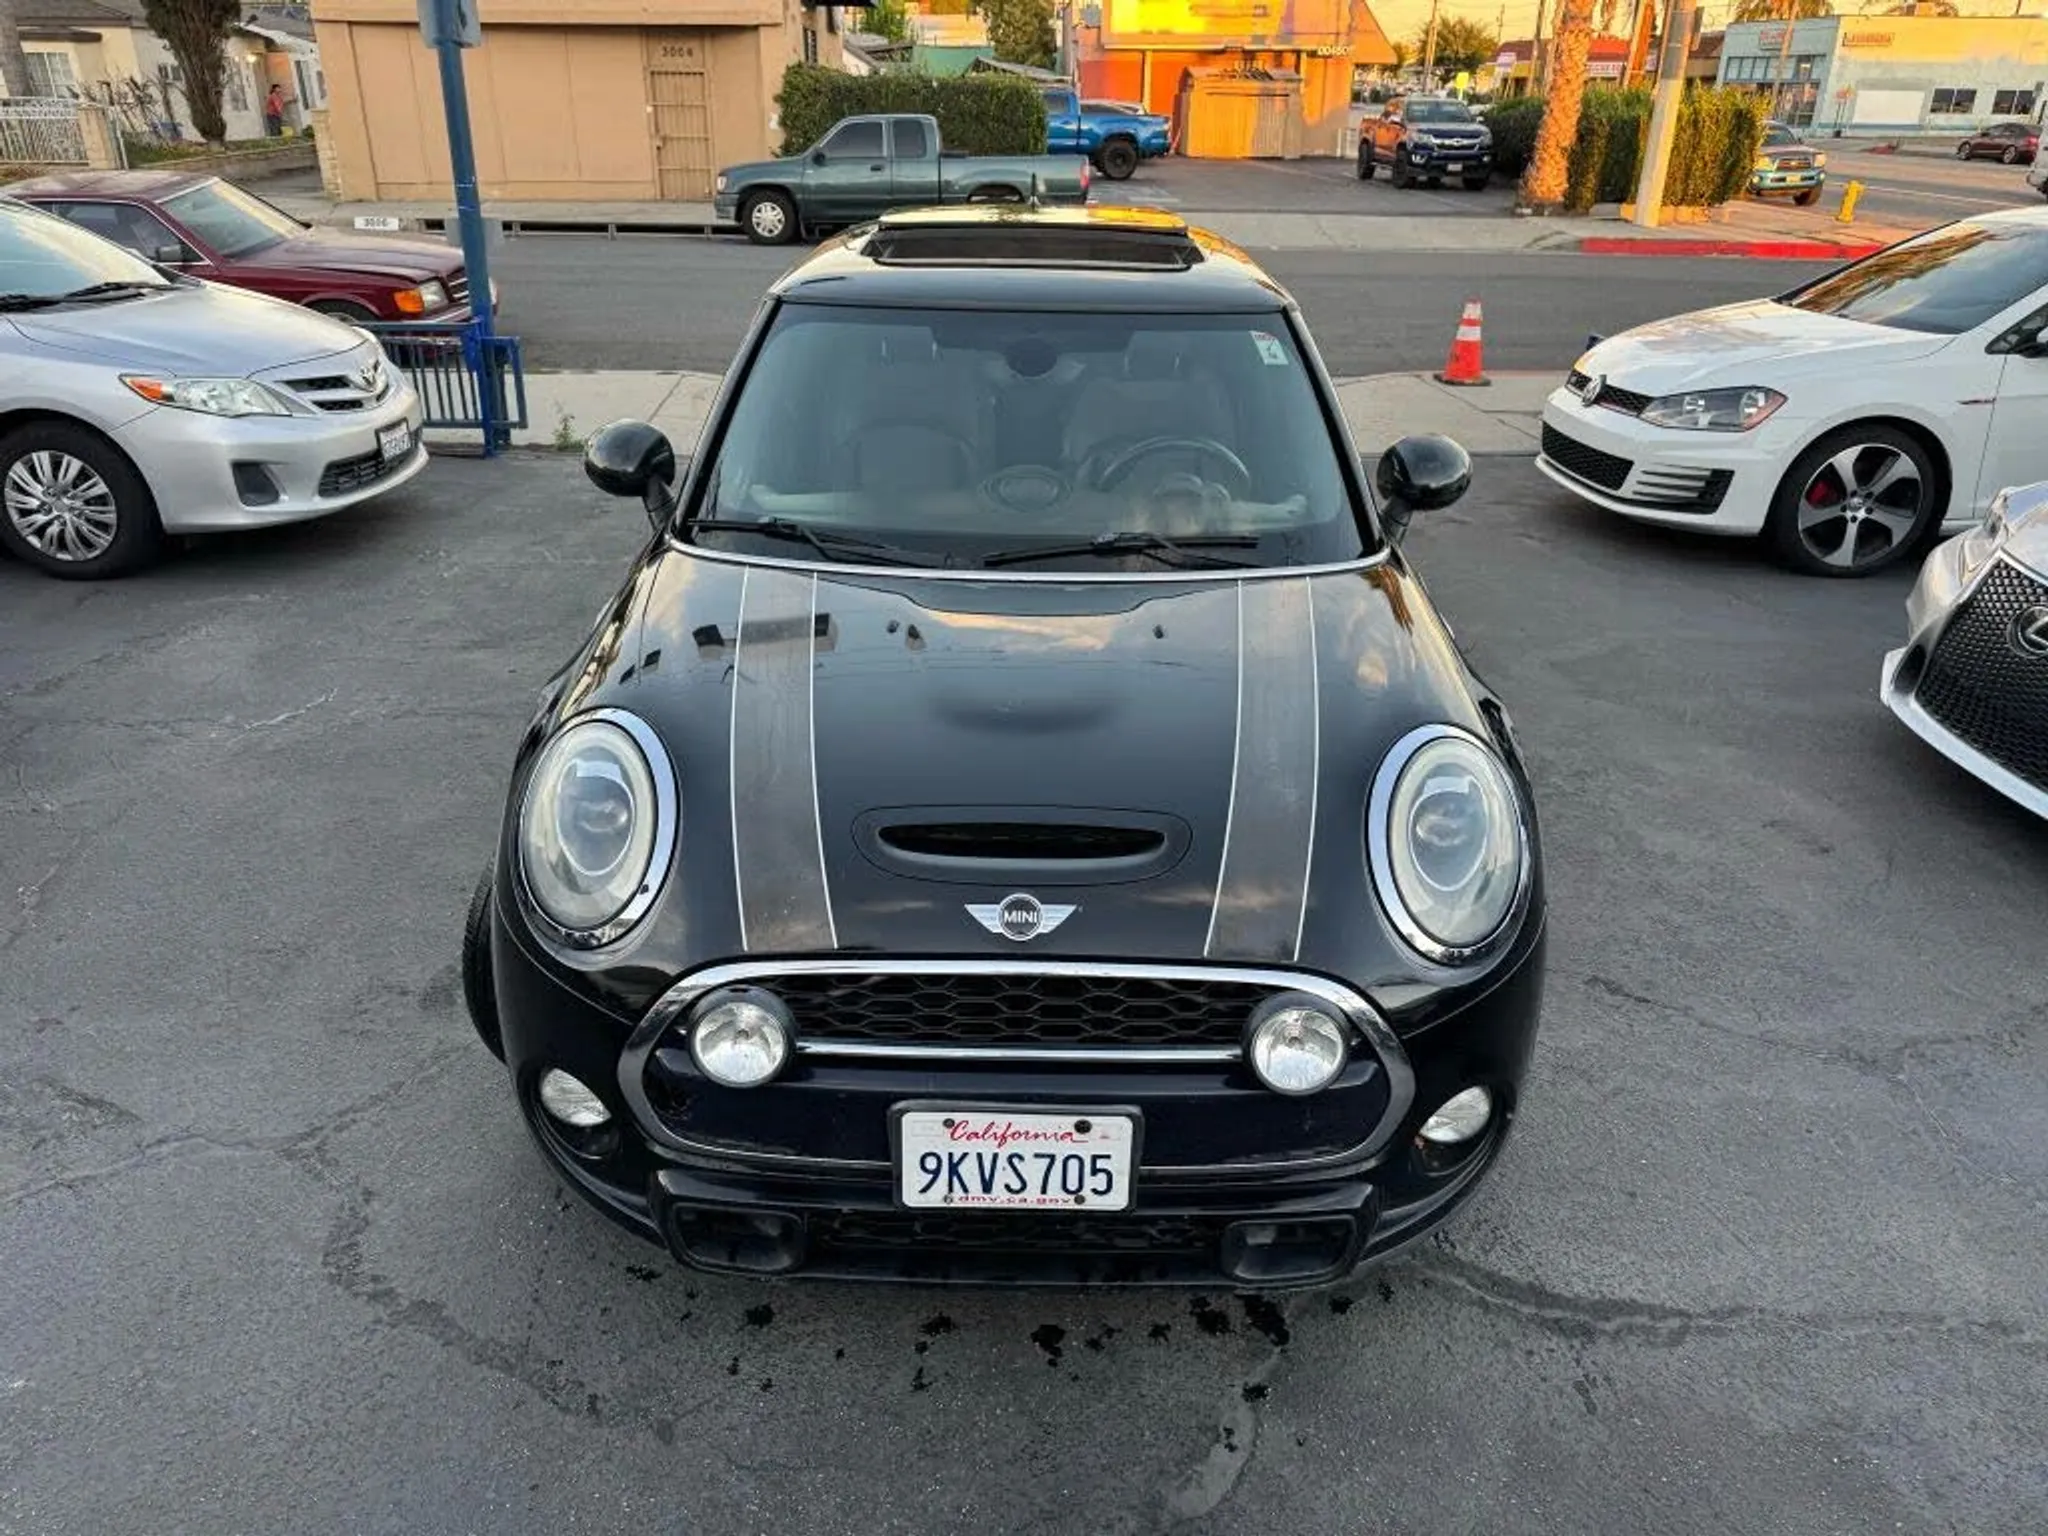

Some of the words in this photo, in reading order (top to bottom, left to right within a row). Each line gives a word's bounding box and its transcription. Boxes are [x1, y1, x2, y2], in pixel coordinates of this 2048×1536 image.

[1003, 910, 1038, 923] MINI
[949, 1120, 1088, 1149] California
[918, 1151, 1114, 1196] 9KVS705
[957, 1195, 1072, 1205] dmv.ca.gov
